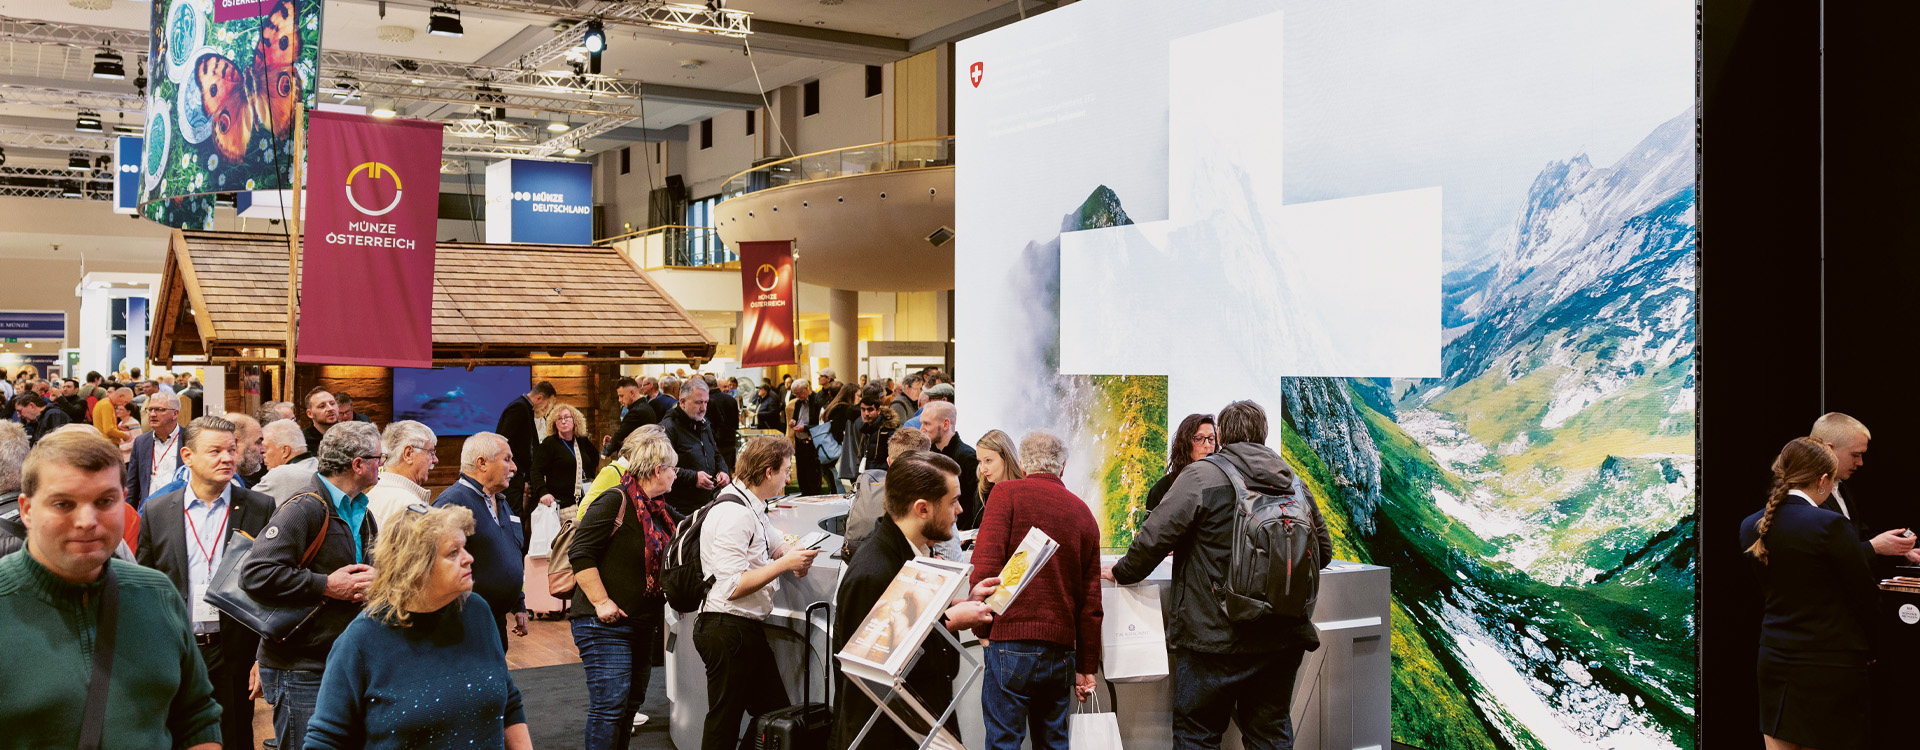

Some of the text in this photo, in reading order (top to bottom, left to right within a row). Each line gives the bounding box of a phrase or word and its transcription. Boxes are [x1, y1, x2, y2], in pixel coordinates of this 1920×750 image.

[531, 191, 564, 203] MÜNZE
[531, 203, 591, 215] DEUTSCHLAND
[348, 220, 397, 235] MÜNZE
[325, 231, 416, 250] ÖSTERREICH
[757, 293, 778, 301] MÜNZE
[750, 300, 786, 309] ÖSTERREICH
[5, 321, 30, 329] MÜNZE
